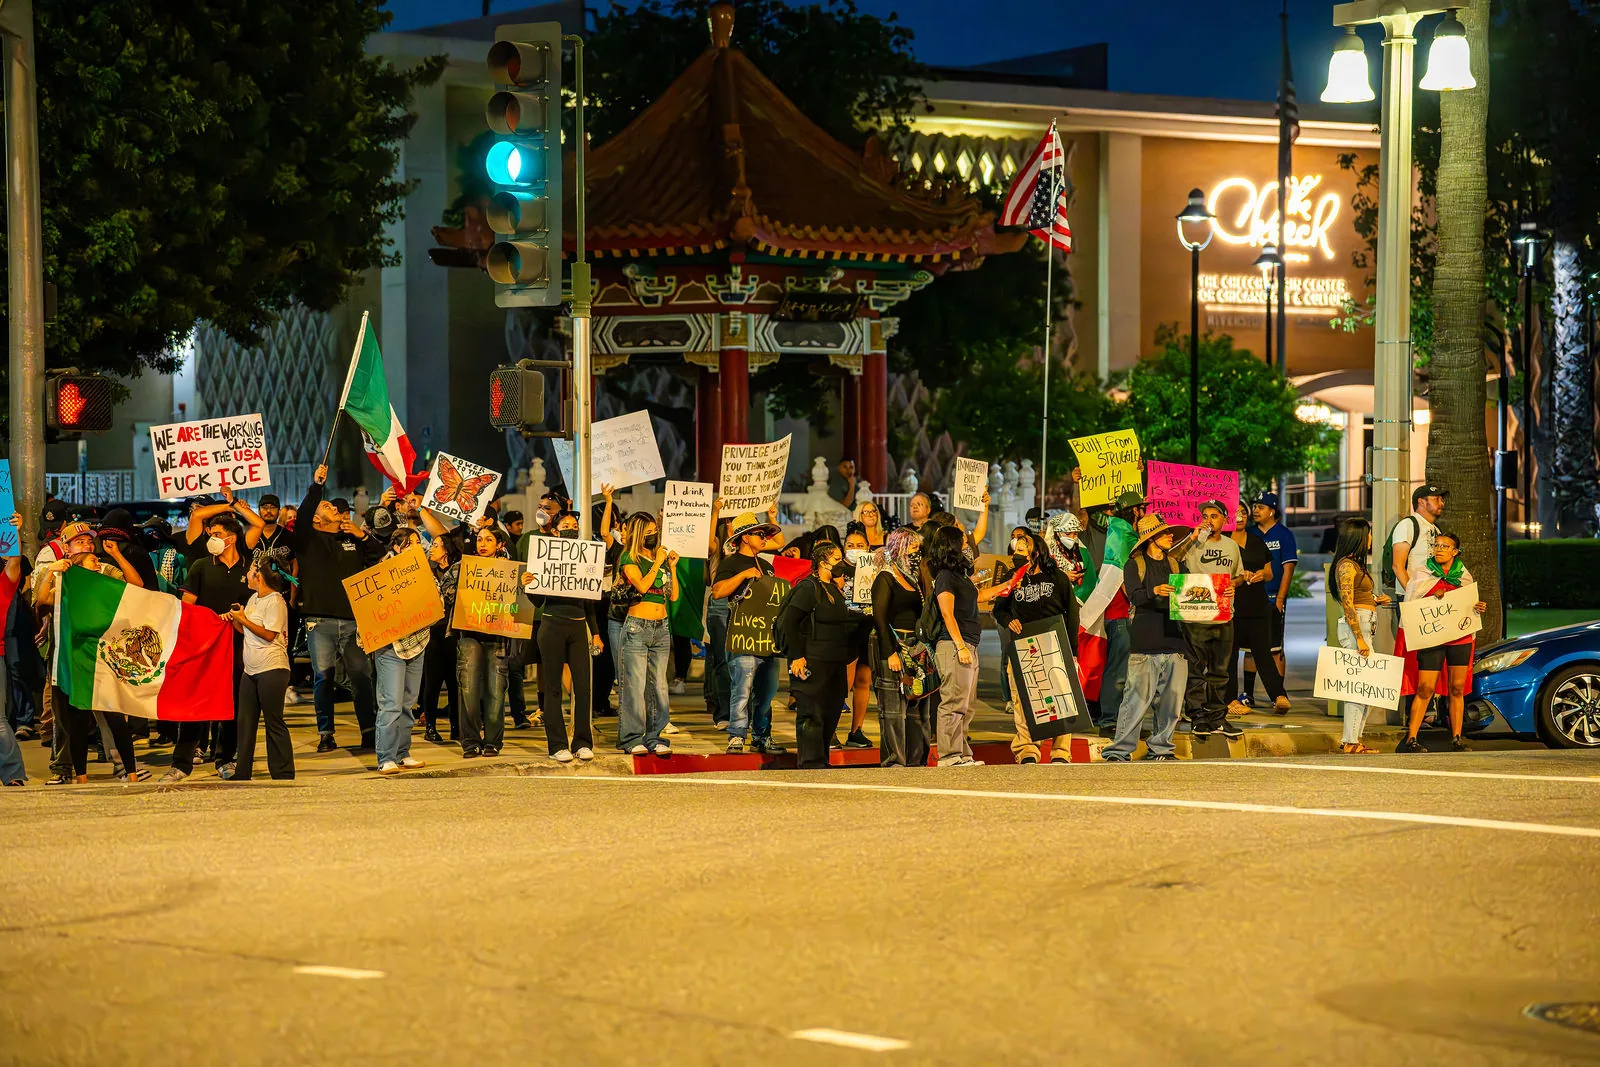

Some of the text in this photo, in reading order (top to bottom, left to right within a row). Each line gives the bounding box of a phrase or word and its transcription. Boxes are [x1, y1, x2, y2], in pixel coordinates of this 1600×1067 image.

[154, 421, 263, 451] WE ARE THE WORKING
[226, 437, 262, 450] CLASS
[724, 446, 770, 459] PRIVILEGE
[1098, 448, 1138, 469] STRUGGLE
[157, 449, 263, 473] WE ARE THE USA
[452, 457, 485, 473] POWER
[725, 462, 742, 471] YOU
[746, 462, 766, 471] THINK
[162, 464, 261, 493] FUCK ICE
[723, 474, 732, 482] IS
[736, 474, 752, 483] NOT
[756, 473, 761, 482] A
[964, 473, 980, 484] BUILT
[673, 484, 704, 496] I drink
[724, 485, 757, 496] BECAUSE
[760, 483, 771, 493] YOU
[963, 484, 976, 492] THIS
[667, 500, 678, 509] my
[723, 497, 760, 510] AFFECTED
[959, 493, 981, 507] NATION
[428, 500, 472, 523] PEOPLE
[537, 538, 603, 563] DEPORT
[1205, 549, 1223, 557] JUST
[466, 563, 482, 578] WE
[485, 568, 504, 579] ARE
[544, 562, 577, 575] WHITE
[350, 572, 387, 601] ICE
[466, 579, 491, 592] WILL
[529, 573, 602, 592] SUPREMACY
[485, 592, 504, 602] BE A
[372, 600, 403, 623] 1600
[471, 601, 519, 624] NATION
[486, 614, 498, 623] OF
[733, 602, 766, 629] Lives
[1420, 604, 1458, 621] FUCK
[1419, 620, 1444, 636] ICE
[731, 631, 781, 653] matte
[1334, 650, 1389, 670] PRODUCT
[1036, 635, 1077, 715] ICE
[1323, 678, 1398, 701] IMMIGRANTS
